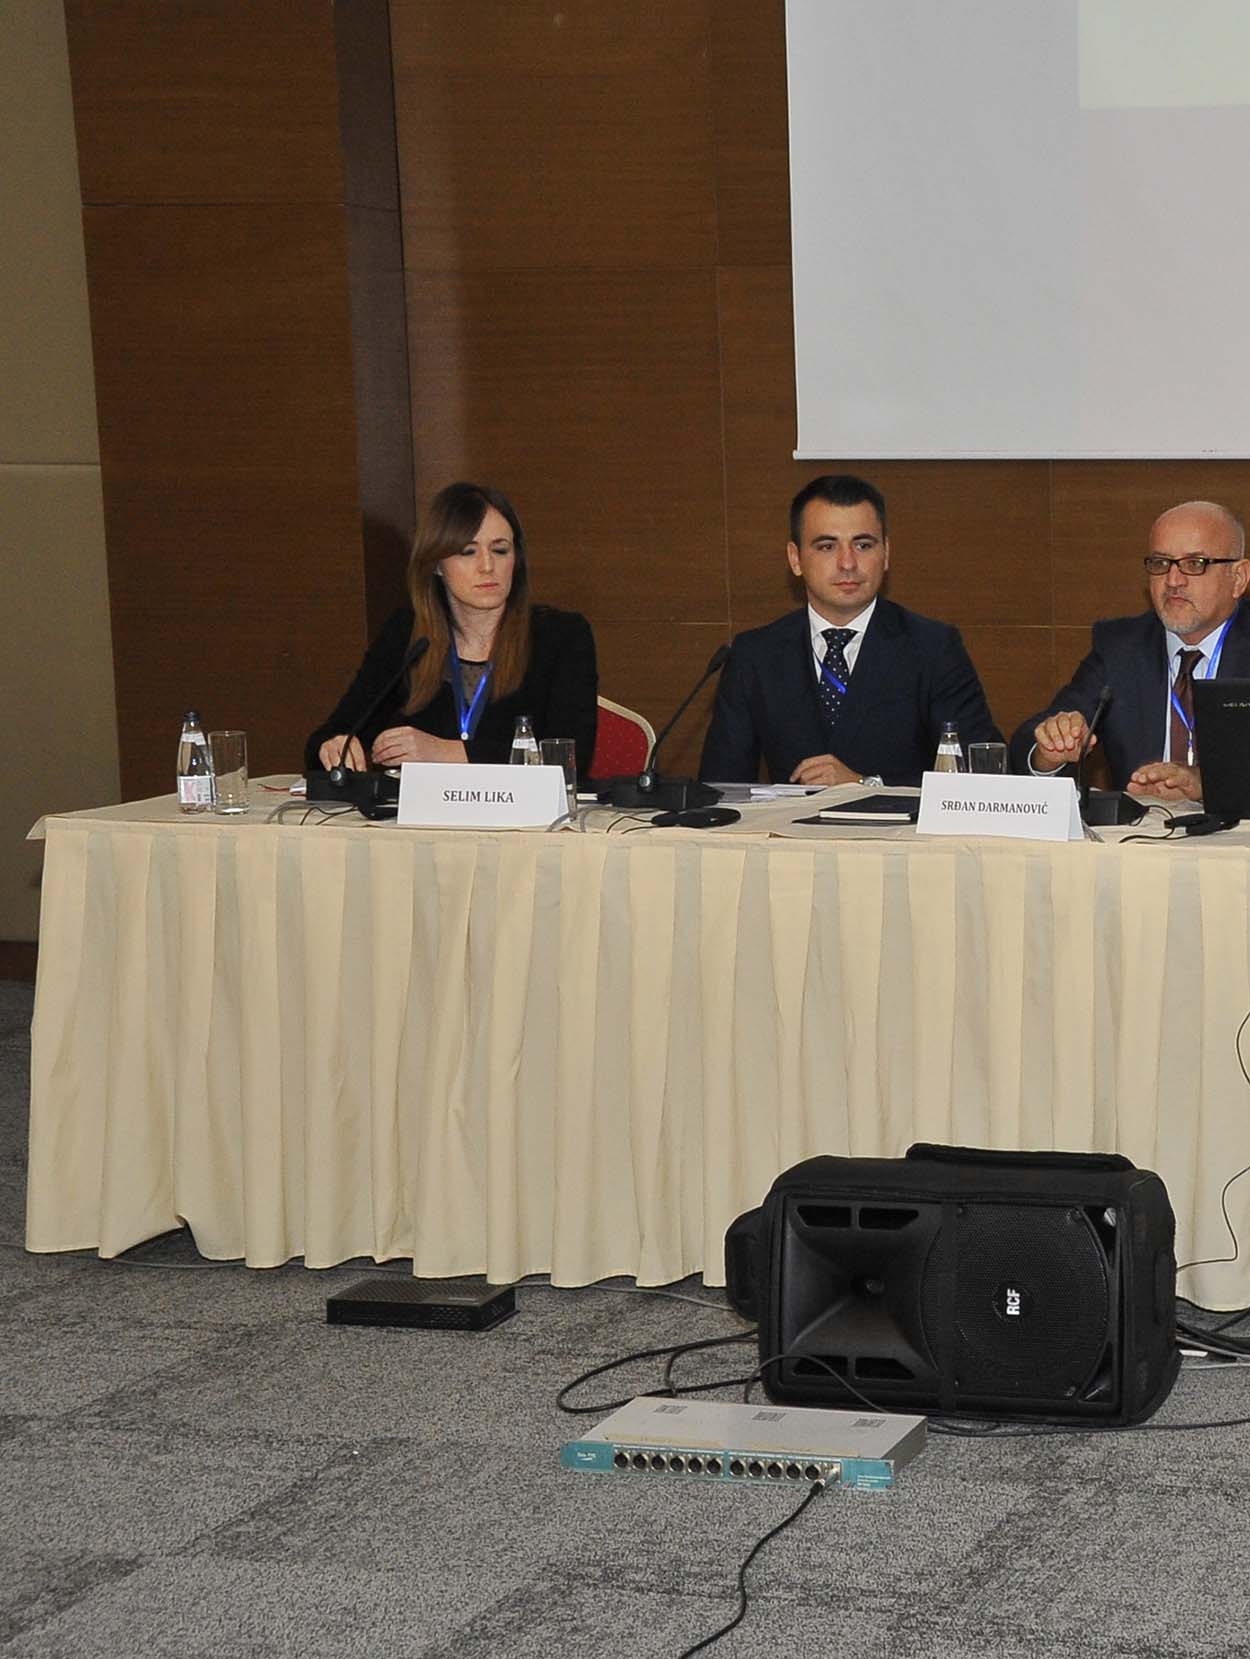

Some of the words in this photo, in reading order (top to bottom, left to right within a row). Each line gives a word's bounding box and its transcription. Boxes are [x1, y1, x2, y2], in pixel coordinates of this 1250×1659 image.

[442, 790, 481, 803] SELIM
[484, 791, 514, 804] LIKA
[978, 801, 1049, 815] DARMANOVIĆ
[1006, 1288, 1021, 1316] RCF
